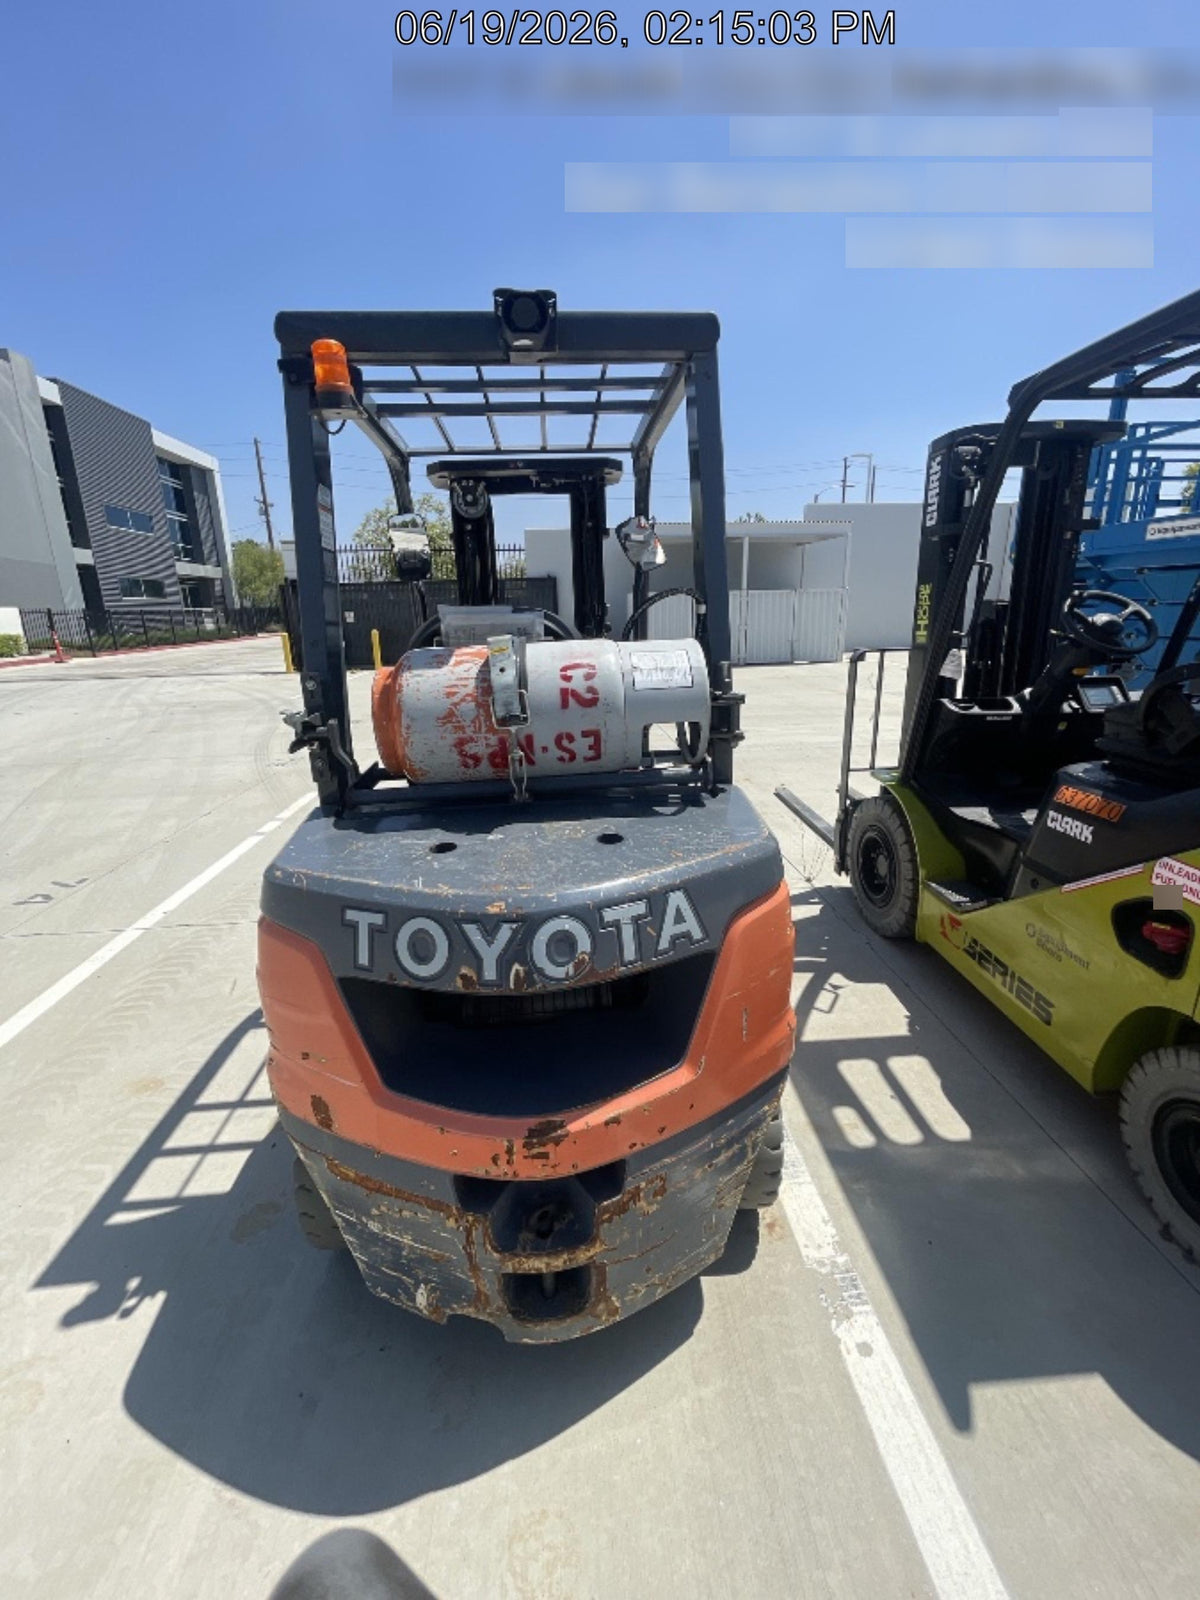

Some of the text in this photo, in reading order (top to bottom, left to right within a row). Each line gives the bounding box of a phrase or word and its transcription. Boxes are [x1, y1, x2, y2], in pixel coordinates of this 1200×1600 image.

[926, 453, 942, 527] CLARK
[560, 661, 600, 710] C2
[1047, 809, 1094, 844] CLARK
[341, 887, 709, 985] TOYOTA
